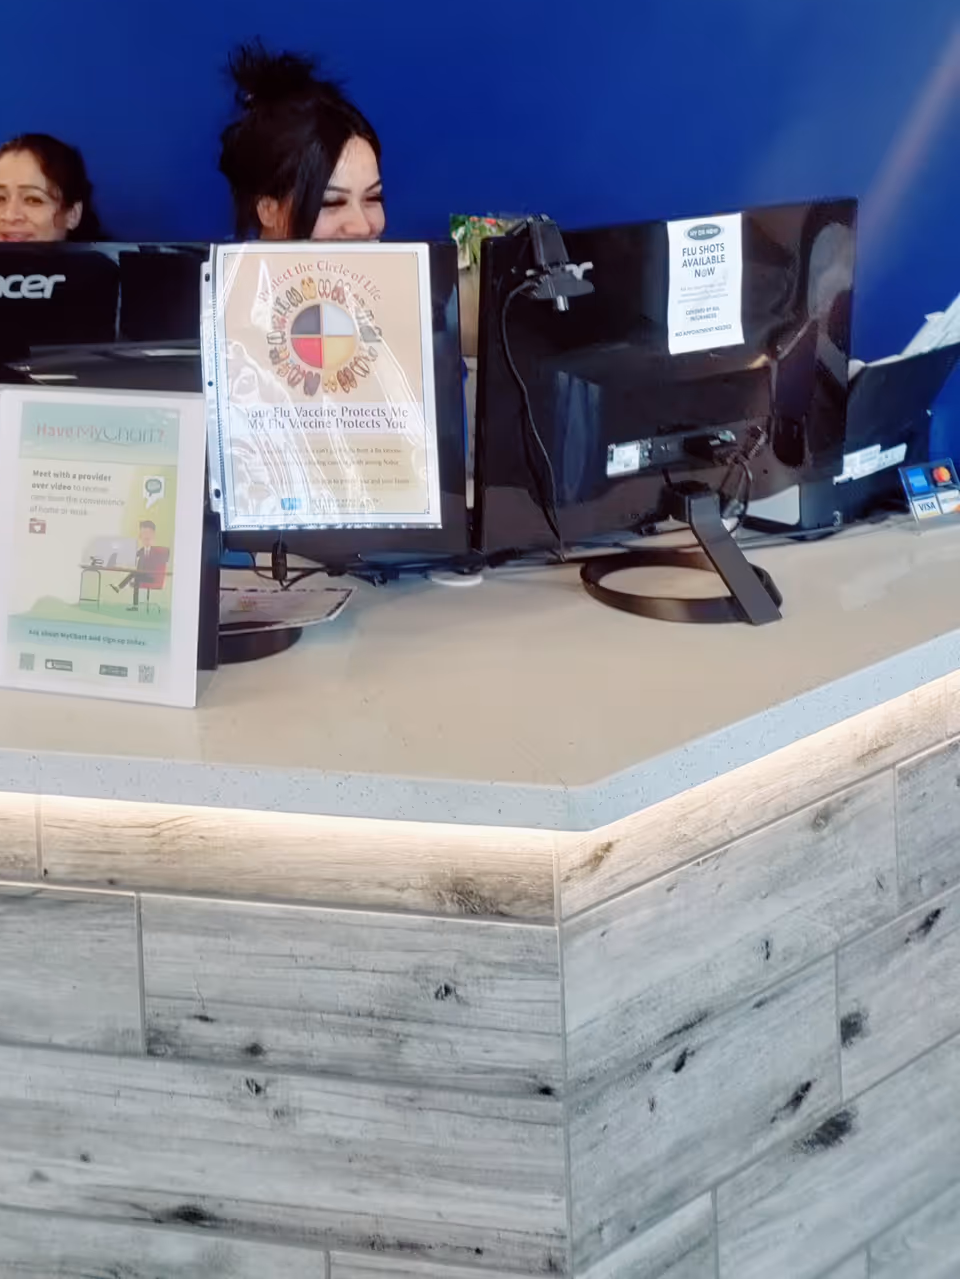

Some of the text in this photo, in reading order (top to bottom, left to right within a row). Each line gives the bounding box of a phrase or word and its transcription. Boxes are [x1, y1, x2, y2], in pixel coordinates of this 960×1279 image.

[682, 243, 725, 256] FLU SHOTS
[682, 254, 725, 268] AVAILABLE
[695, 267, 715, 278] NOW
[294, 262, 314, 276] the
[317, 259, 350, 278] Circle
[351, 272, 365, 285] of
[362, 279, 382, 302] Life
[273, 406, 290, 418] Flu
[294, 406, 337, 418] Vaccine
[341, 406, 386, 418] Protects
[391, 407, 409, 418] Me
[247, 417, 407, 431] My Flu Vaccine Protects You
[36, 423, 74, 438] Have
[32, 470, 51, 478] Meet
[53, 470, 70, 479] with
[78, 472, 112, 482] provider
[50, 482, 72, 491] video
[30, 505, 38, 513] of
[918, 501, 936, 511] VISA
[61, 632, 88, 641] MyChart
